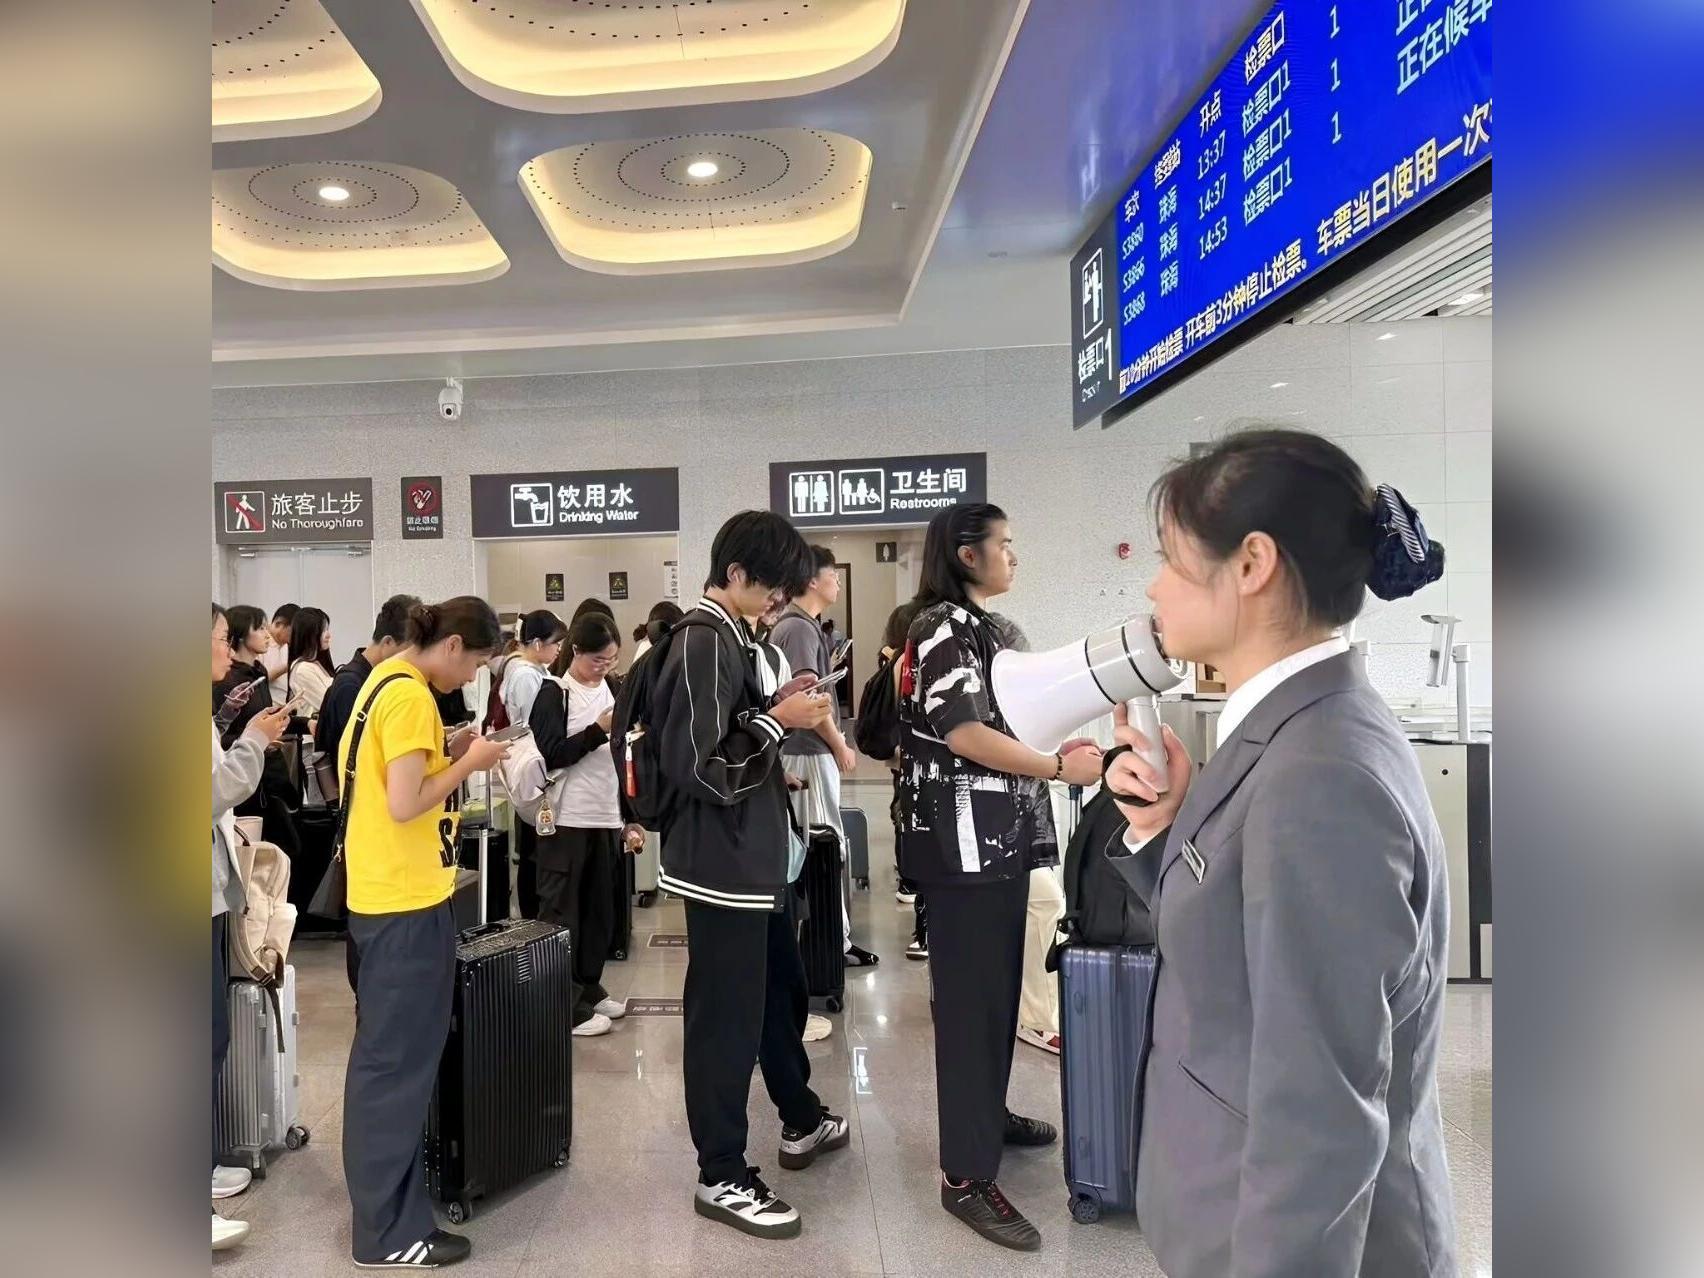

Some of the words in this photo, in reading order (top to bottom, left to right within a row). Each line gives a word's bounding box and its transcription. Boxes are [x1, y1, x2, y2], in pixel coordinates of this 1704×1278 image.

[1244, 9, 1285, 86] 检票口
[1198, 129, 1226, 180] 13:37
[1241, 59, 1291, 138] 检票口1
[1329, 4, 1341, 39] 1
[1198, 172, 1227, 220] 14:37
[1242, 107, 1292, 182] 检票口1
[1330, 57, 1341, 92] 1
[1199, 215, 1228, 260] 14:53
[1242, 156, 1293, 227] 检票口1
[1331, 111, 1342, 144] 1
[1316, 98, 1492, 256] 车票当日使用一次
[271, 490, 363, 516] 旅客止步
[557, 482, 634, 509] 饮用水
[889, 468, 967, 494] 卫生间
[272, 518, 288, 530] No
[559, 511, 604, 524] Drinking
[605, 509, 640, 521] Water
